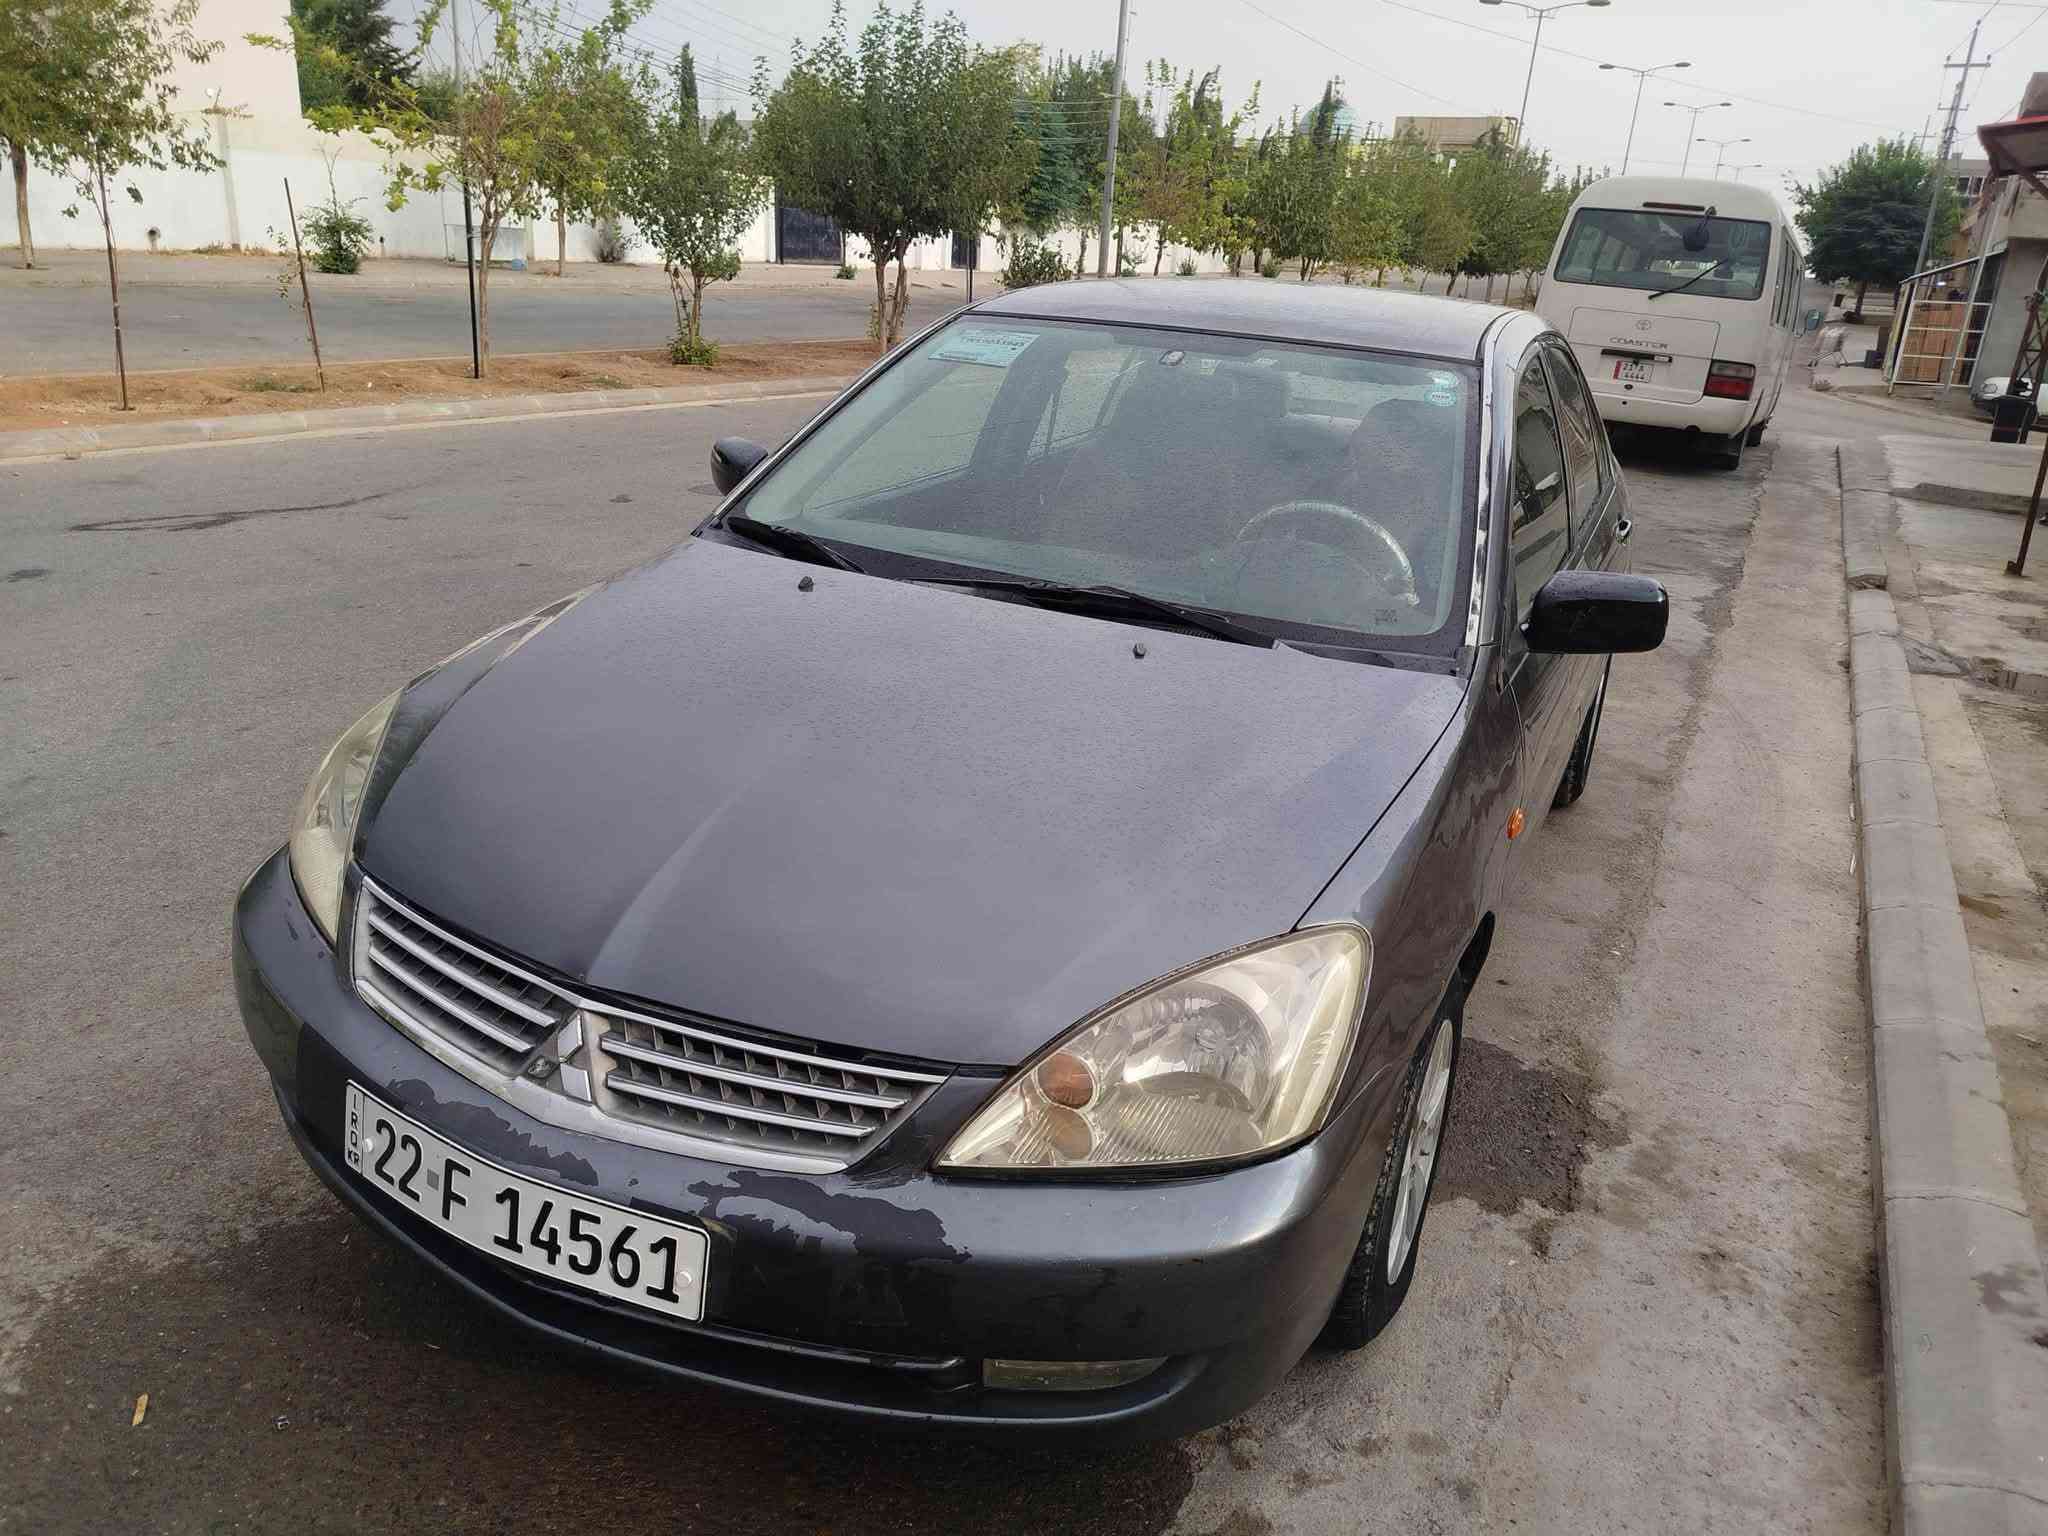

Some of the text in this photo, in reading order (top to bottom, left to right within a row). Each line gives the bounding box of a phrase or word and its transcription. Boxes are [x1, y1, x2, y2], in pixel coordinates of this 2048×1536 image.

[1609, 337, 1668, 349] COASTER
[348, 1148, 360, 1166] KR
[374, 1118, 680, 1304] 22 F 14561
